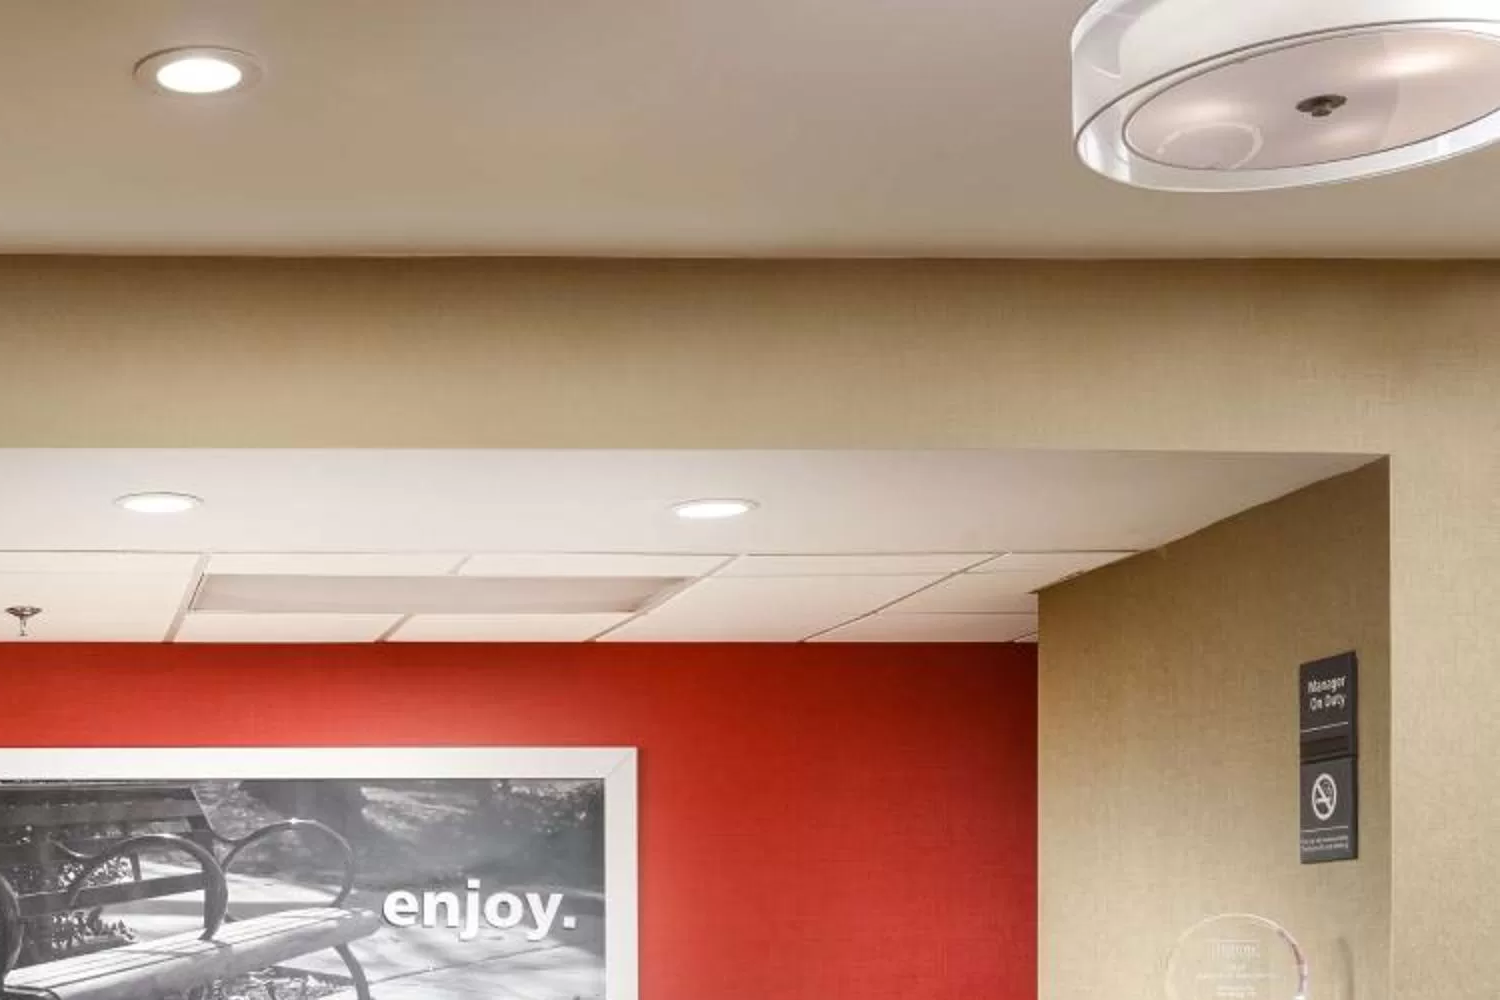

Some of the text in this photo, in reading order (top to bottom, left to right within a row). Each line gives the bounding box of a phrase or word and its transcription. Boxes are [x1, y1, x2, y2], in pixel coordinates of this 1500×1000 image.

[1308, 676, 1346, 693] Manager
[1310, 694, 1346, 710] On Duty
[382, 878, 577, 942] enjoy.
